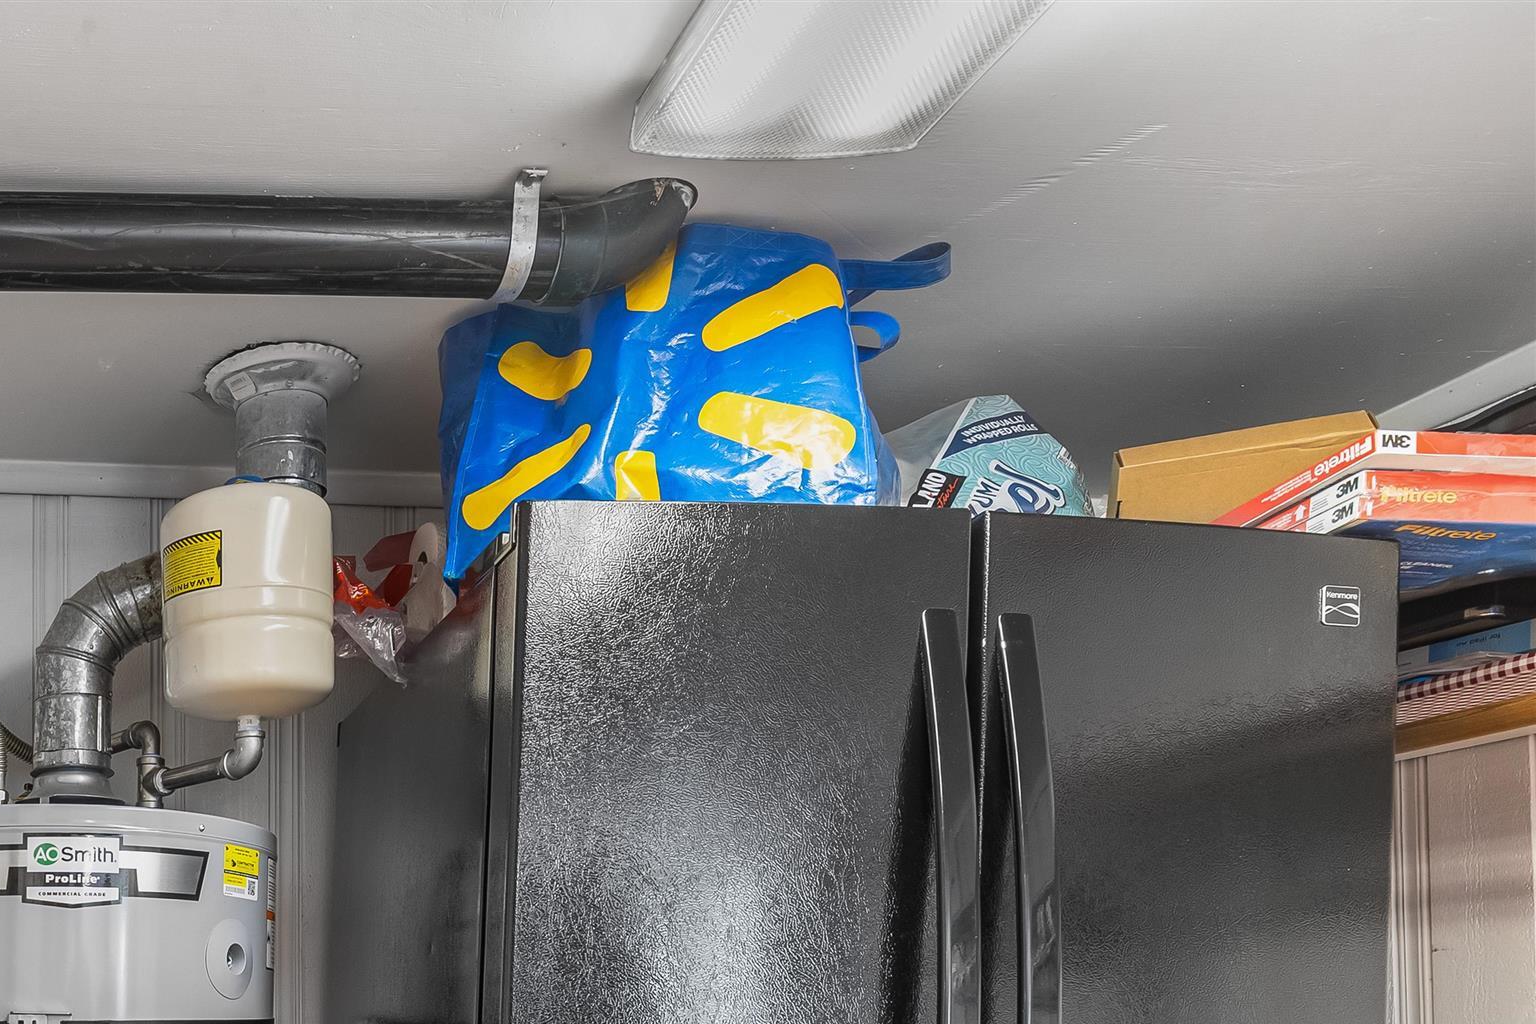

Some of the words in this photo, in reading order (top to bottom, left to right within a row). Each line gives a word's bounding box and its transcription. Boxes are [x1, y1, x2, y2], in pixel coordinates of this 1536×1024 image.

[961, 415, 1026, 438] INDIVIDUALLY
[963, 427, 1013, 445] WRAPPED
[1013, 423, 1039, 434] ROLLS
[1382, 434, 1411, 449] 3M
[1314, 435, 1374, 476] Filtrete
[1336, 476, 1359, 499] 3M
[1380, 486, 1458, 504] Filtrete
[1331, 501, 1354, 524] 3M
[1393, 524, 1498, 541] Filtrete
[165, 578, 206, 597] WARNING
[1326, 591, 1358, 600] Kenmore
[34, 845, 61, 863] AO
[61, 846, 114, 863] Smith
